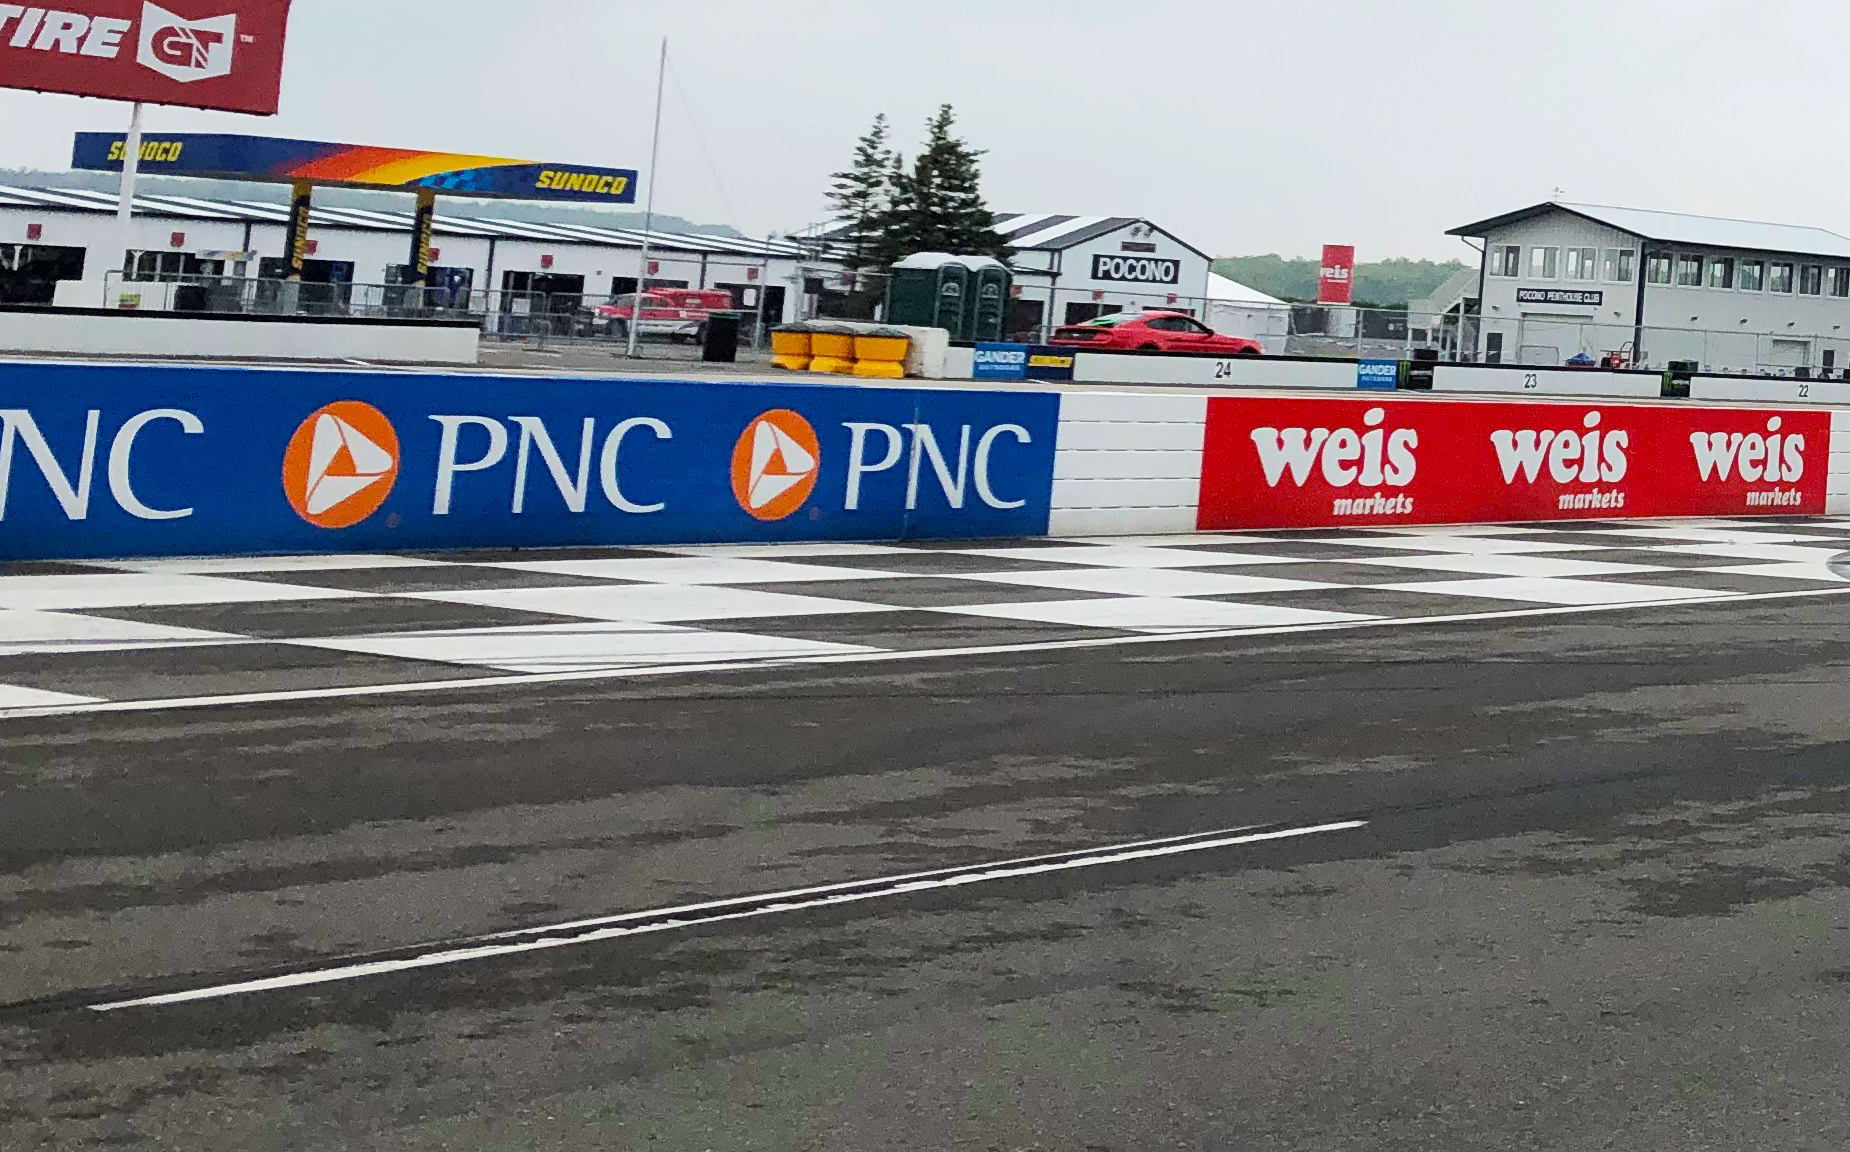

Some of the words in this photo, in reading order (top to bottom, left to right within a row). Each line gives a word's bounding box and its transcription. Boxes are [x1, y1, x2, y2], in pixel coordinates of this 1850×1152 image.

[0, 3, 132, 59] TIRE
[151, 26, 224, 70] GT
[535, 170, 628, 195] SUNOCO
[1097, 257, 1175, 282] POCONO
[1215, 361, 1232, 378] 24
[1524, 373, 1538, 389] 23
[1798, 384, 1809, 398] 22
[1250, 407, 1419, 488] weis
[1489, 410, 1629, 484] weis
[1690, 415, 1805, 483] weis
[428, 414, 673, 515] PNC
[841, 421, 1032, 510] PNC
[1333, 491, 1414, 516] markets
[1558, 487, 1625, 510] markets
[1746, 486, 1802, 507] markets
